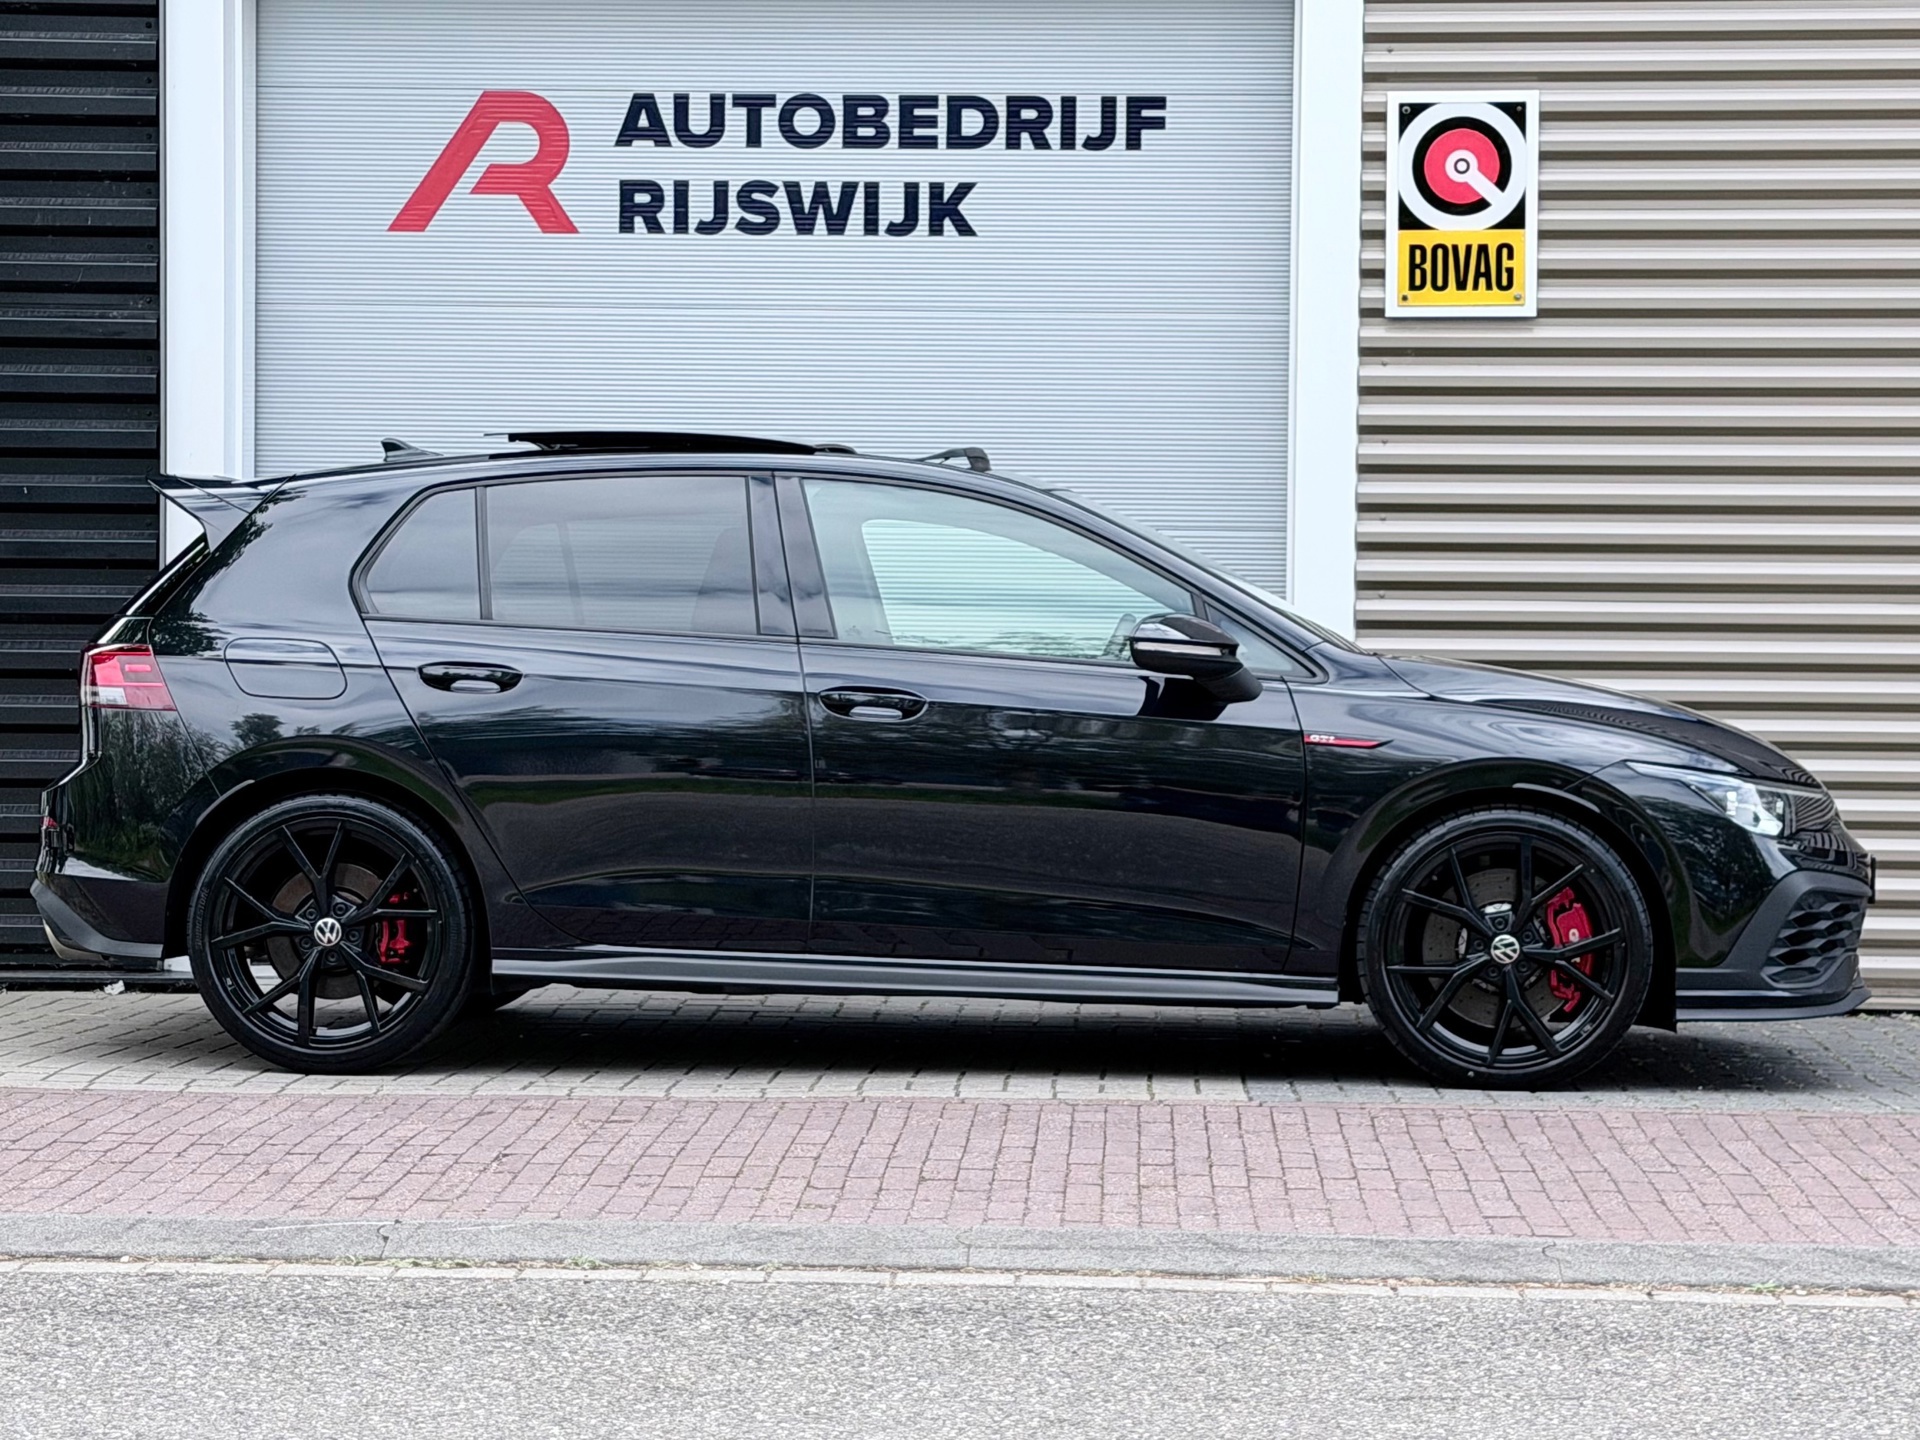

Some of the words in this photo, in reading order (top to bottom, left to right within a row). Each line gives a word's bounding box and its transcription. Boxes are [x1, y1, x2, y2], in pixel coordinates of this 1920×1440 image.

[614, 93, 1168, 152] AUTOBEDRIJF
[617, 179, 978, 237] RIJSWIJK
[1408, 242, 1515, 292] BOVAG
[1309, 734, 1336, 744] GTI
